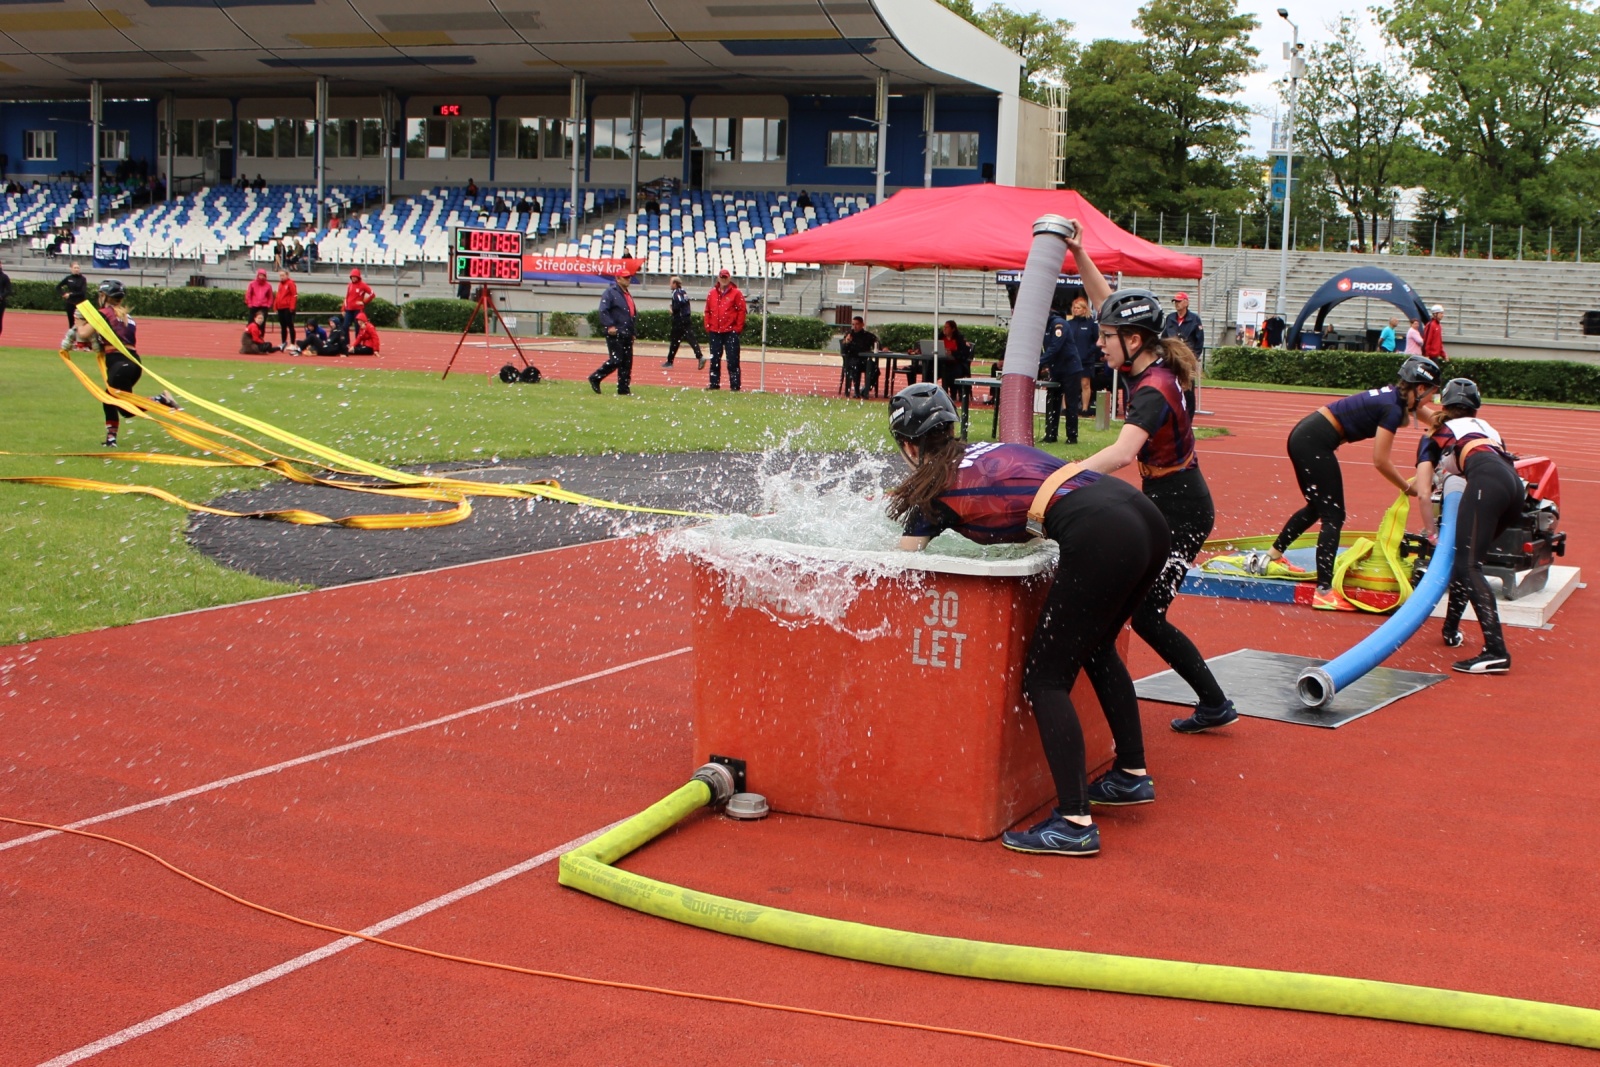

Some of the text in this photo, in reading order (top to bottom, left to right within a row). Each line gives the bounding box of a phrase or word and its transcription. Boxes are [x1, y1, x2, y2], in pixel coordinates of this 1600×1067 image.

[457, 231, 519, 253] L 0:07:65
[457, 257, 519, 279] P 0:07:65
[535, 259, 605, 275] Středočeský
[1352, 282, 1393, 291] PROIZS
[923, 589, 959, 628] 30
[912, 628, 967, 670] LET
[691, 900, 742, 922] DUFFEK
